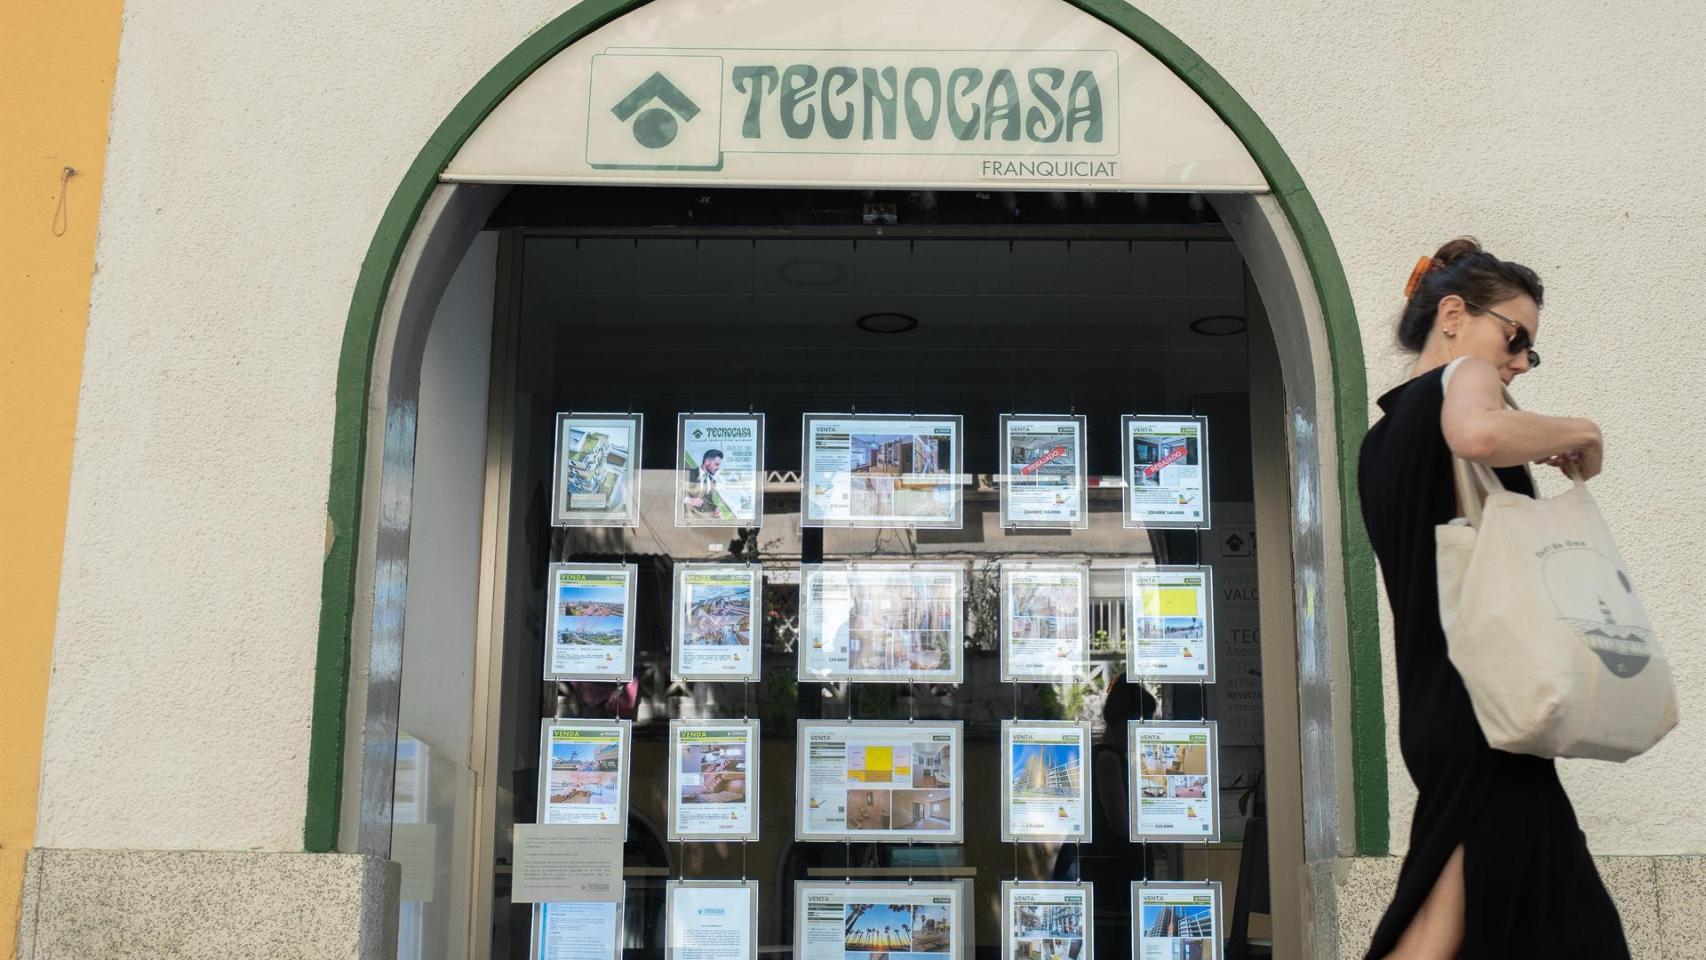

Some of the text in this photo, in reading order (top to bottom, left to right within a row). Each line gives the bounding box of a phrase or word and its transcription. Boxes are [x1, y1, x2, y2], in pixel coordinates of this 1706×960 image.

[732, 65, 1104, 143] TECNOCASA
[983, 161, 1118, 178] FRANQUICIAT
[706, 427, 752, 439] TECNOCASA
[1027, 450, 1060, 473] REBAJADO
[1150, 450, 1183, 473] REBAJADO
[561, 574, 587, 582] VENDA
[552, 730, 580, 738] VENDA
